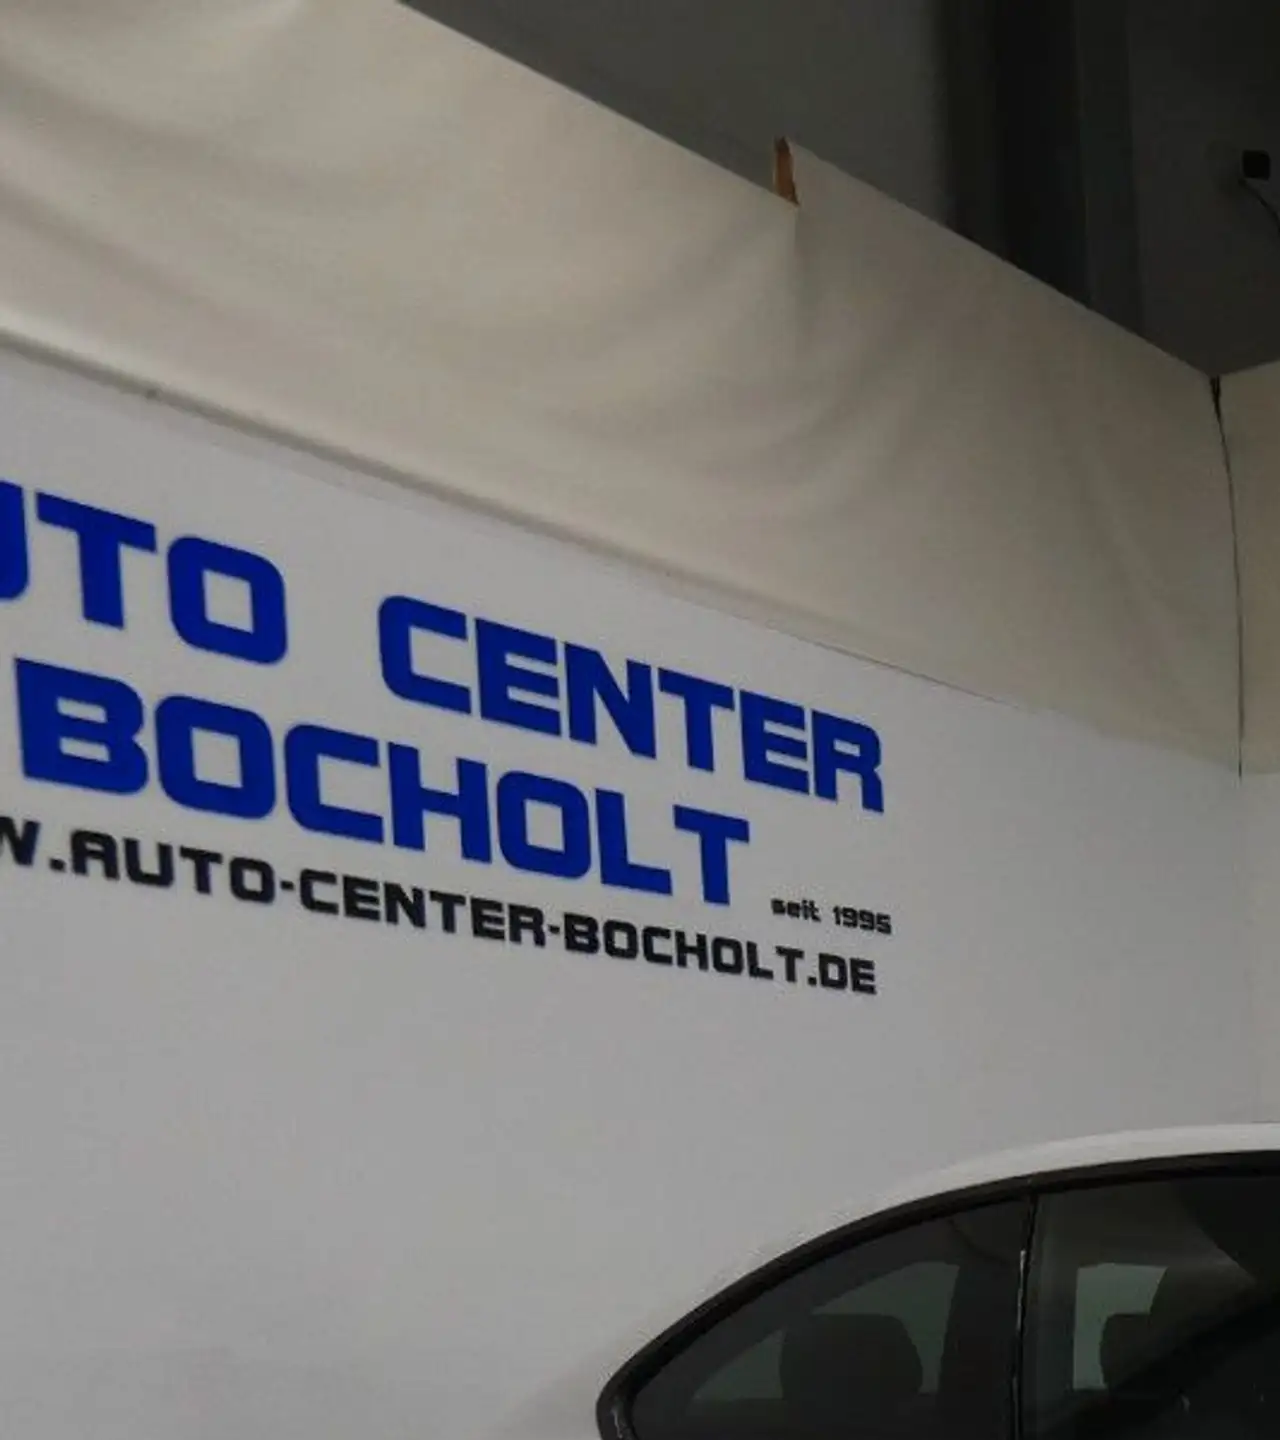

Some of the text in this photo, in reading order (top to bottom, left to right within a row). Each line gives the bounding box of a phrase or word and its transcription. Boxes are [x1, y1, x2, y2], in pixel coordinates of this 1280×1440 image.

[0, 480, 885, 813] TO CENTER
[14, 657, 892, 935] BOCHOLT seit 1995
